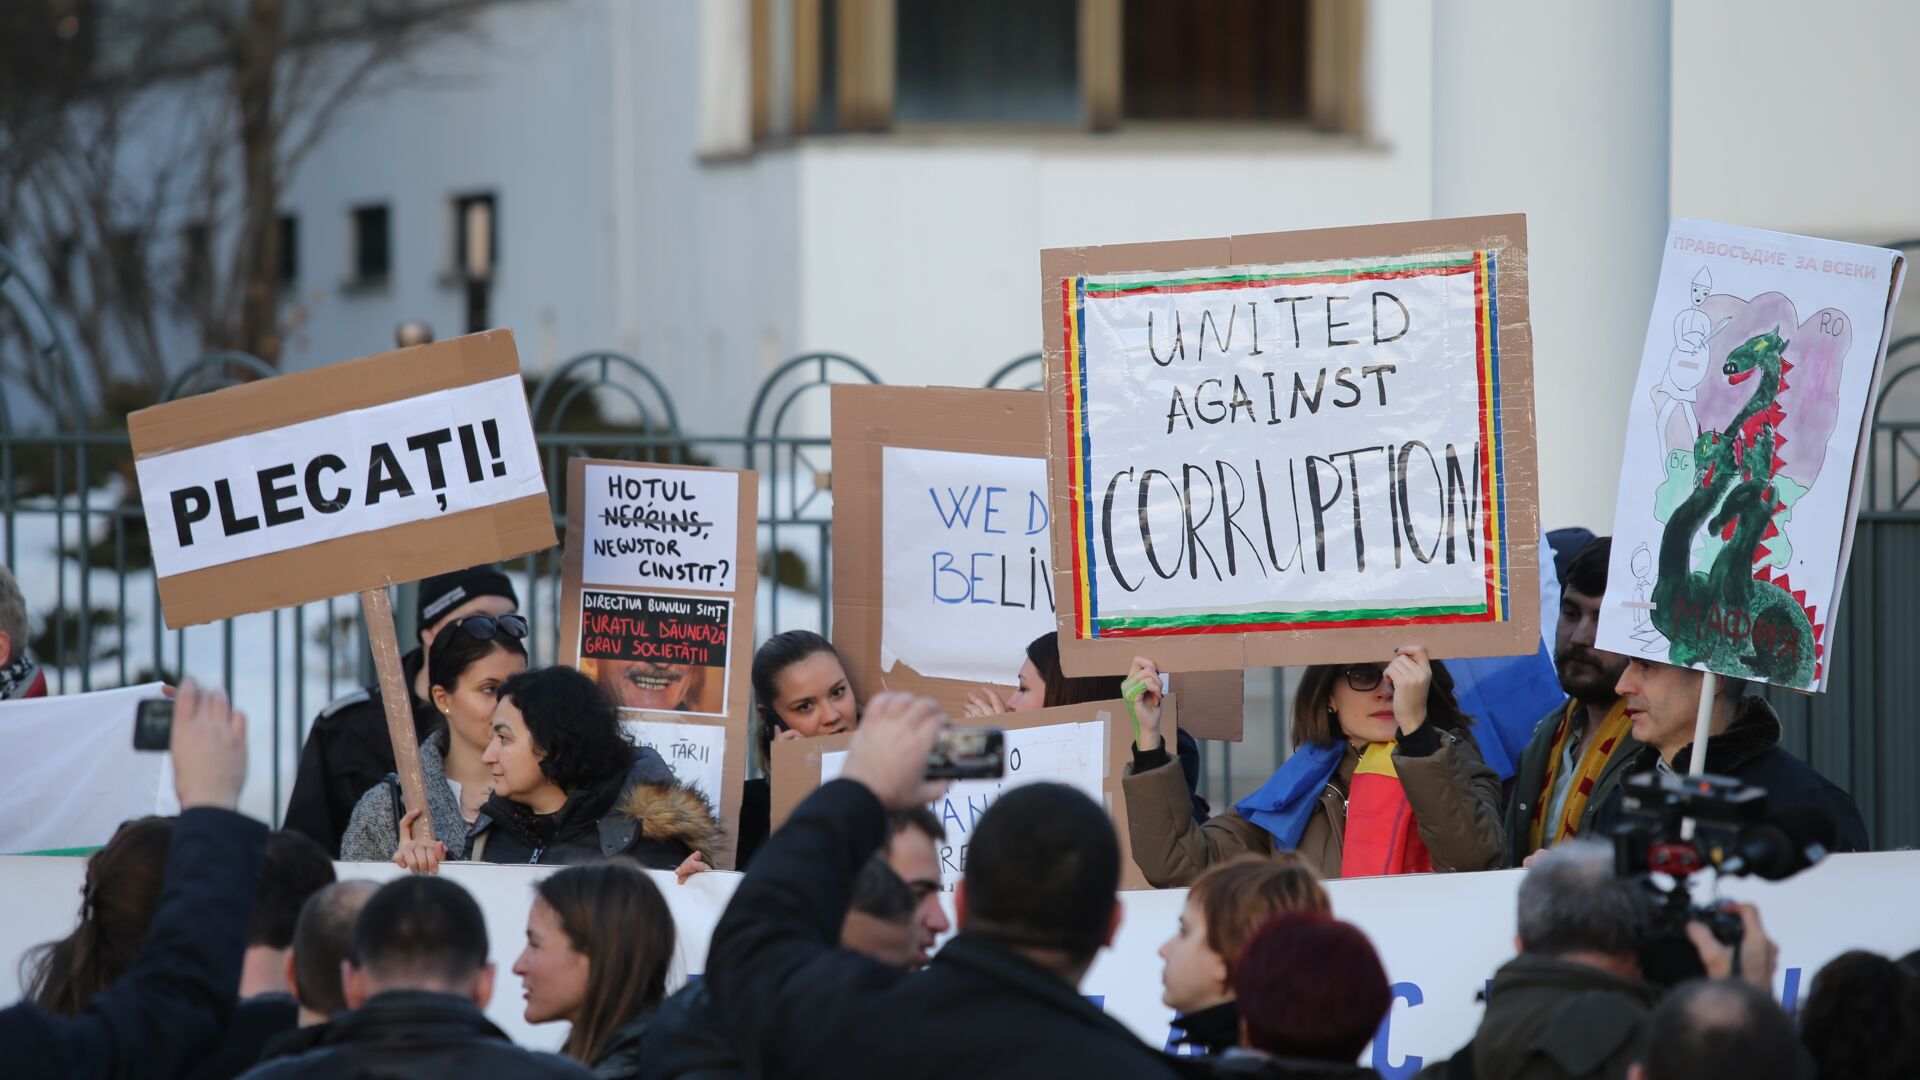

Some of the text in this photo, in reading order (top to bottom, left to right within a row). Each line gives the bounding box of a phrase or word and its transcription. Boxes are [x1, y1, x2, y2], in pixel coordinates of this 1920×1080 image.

[1673, 235, 1878, 281] ПРАВОСЪДИЕ ЗА ВСЕКИ
[1147, 290, 1411, 367] UNITED
[1819, 311, 1845, 337] RO
[1166, 363, 1397, 435] AGAINST
[1670, 451, 1689, 471] BG
[169, 418, 507, 548] PLECAȚI!
[929, 484, 1008, 534] WE
[1101, 440, 1481, 592] CORRUPTION
[593, 536, 682, 558] NEGUSTOR
[638, 558, 730, 587] CINSTIT?
[584, 594, 642, 612] DIRECTIVA
[648, 598, 691, 615] BUNULUI
[583, 612, 650, 638] FURATUL
[585, 636, 622, 655] GRAV
